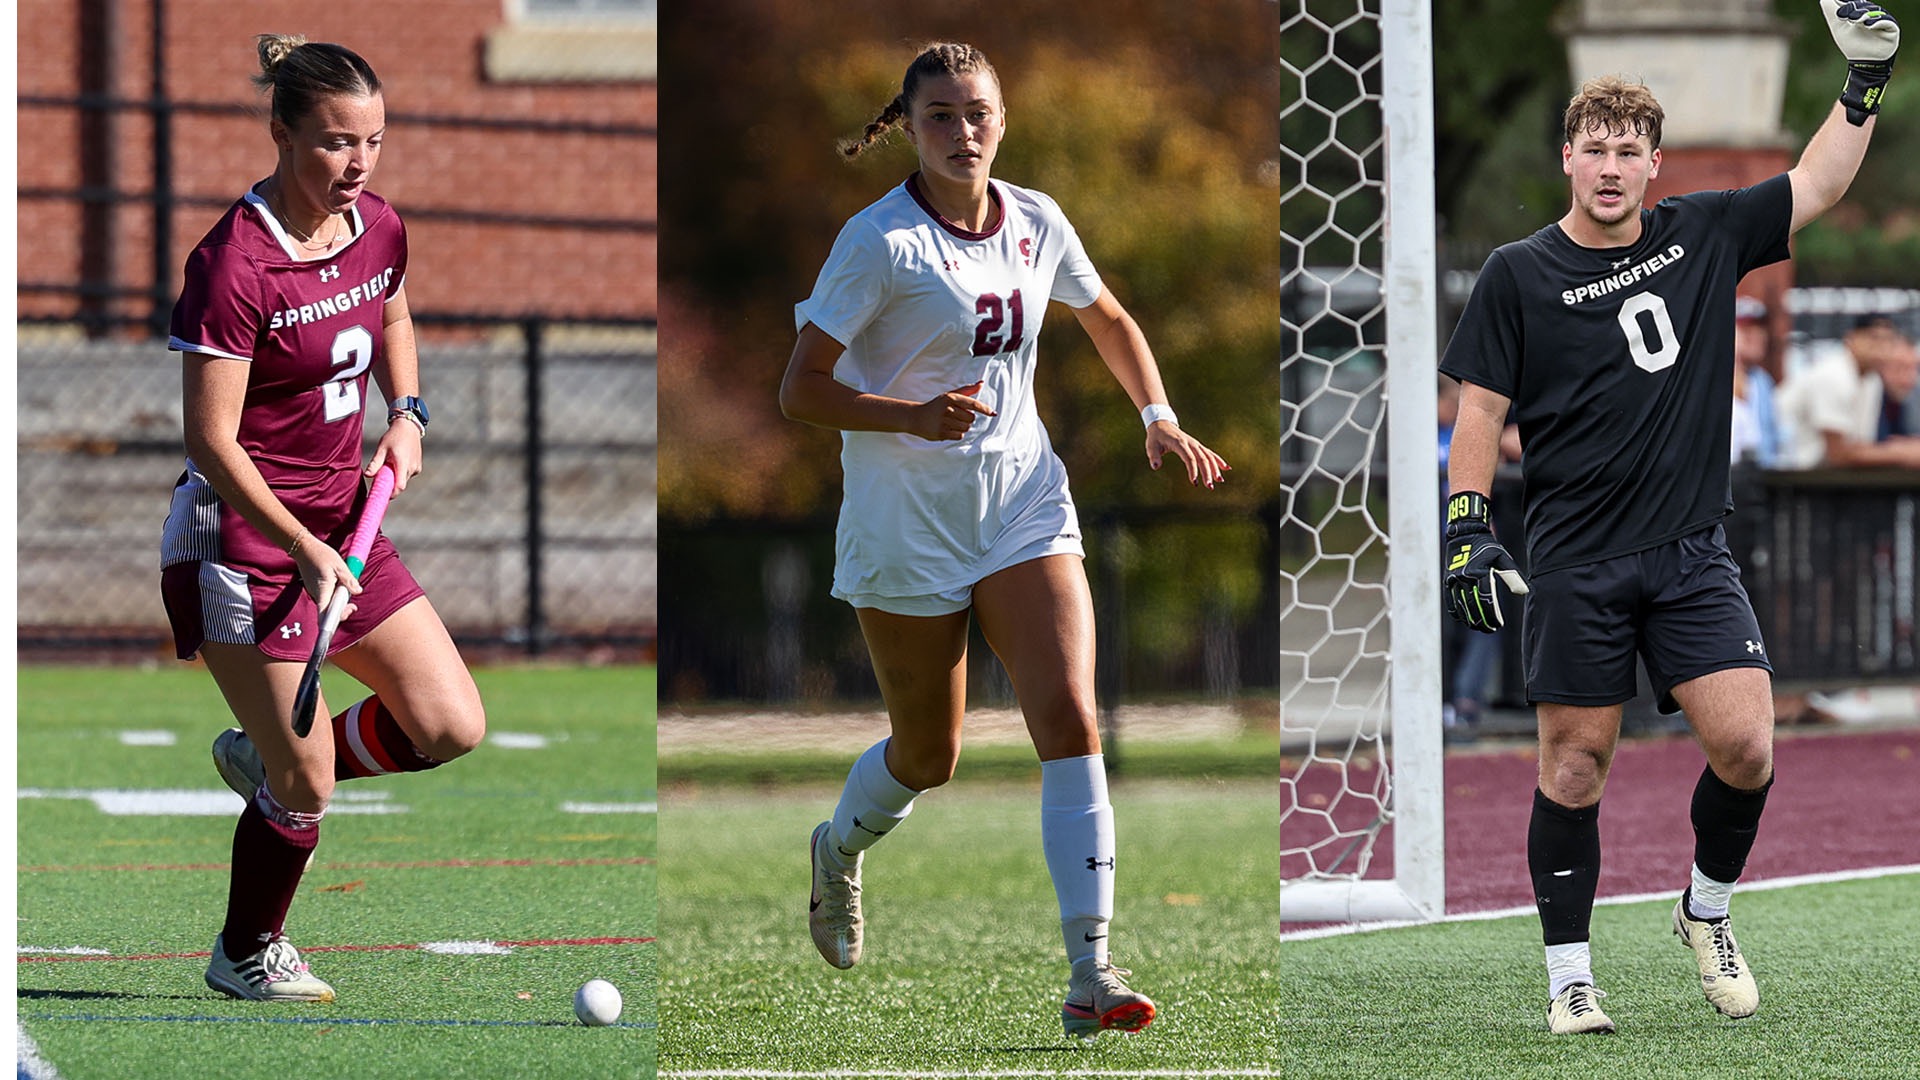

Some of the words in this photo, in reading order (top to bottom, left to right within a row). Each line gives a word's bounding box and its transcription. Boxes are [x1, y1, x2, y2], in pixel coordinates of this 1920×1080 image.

[270, 267, 393, 329] SPRINGFIELD
[1561, 244, 1685, 305] SPRINGFIELD
[972, 288, 1024, 358] 21
[1617, 290, 1681, 373] 0
[321, 324, 374, 424] 2
